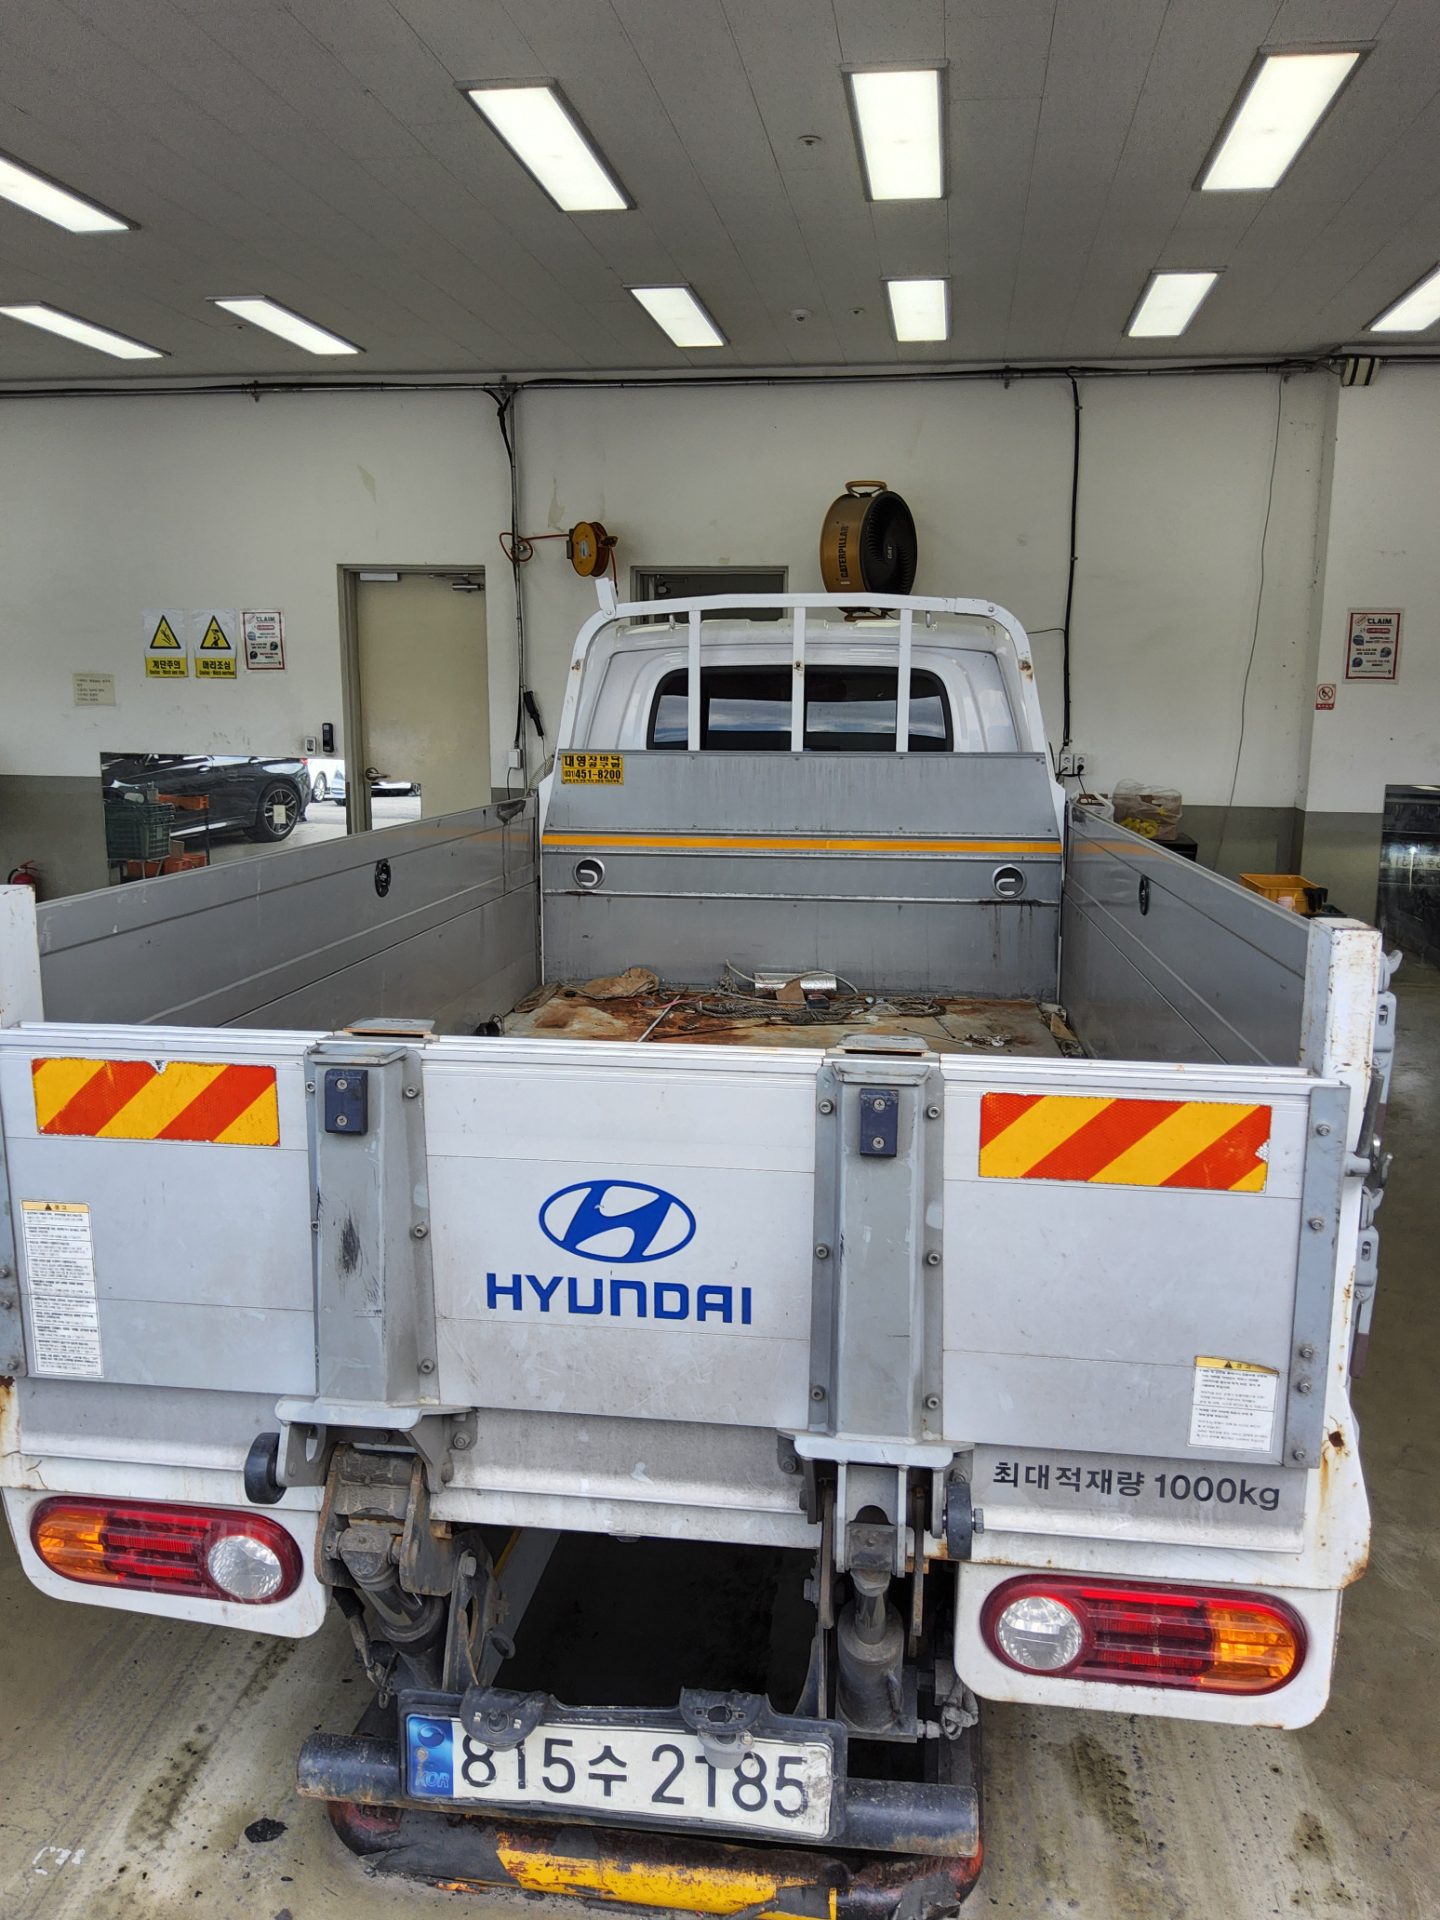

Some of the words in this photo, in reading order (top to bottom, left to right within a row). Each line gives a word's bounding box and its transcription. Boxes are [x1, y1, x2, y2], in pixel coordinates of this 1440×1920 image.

[838, 526, 850, 578] CATERPILLAR
[486, 1273, 752, 1325] HYUNDAI
[993, 1461, 1145, 1497] 최대적재량
[1154, 1473, 1280, 1511] 1000kg
[415, 1771, 449, 1788] KOR
[461, 1735, 628, 1797] 815수
[651, 1743, 808, 1818] 2185
